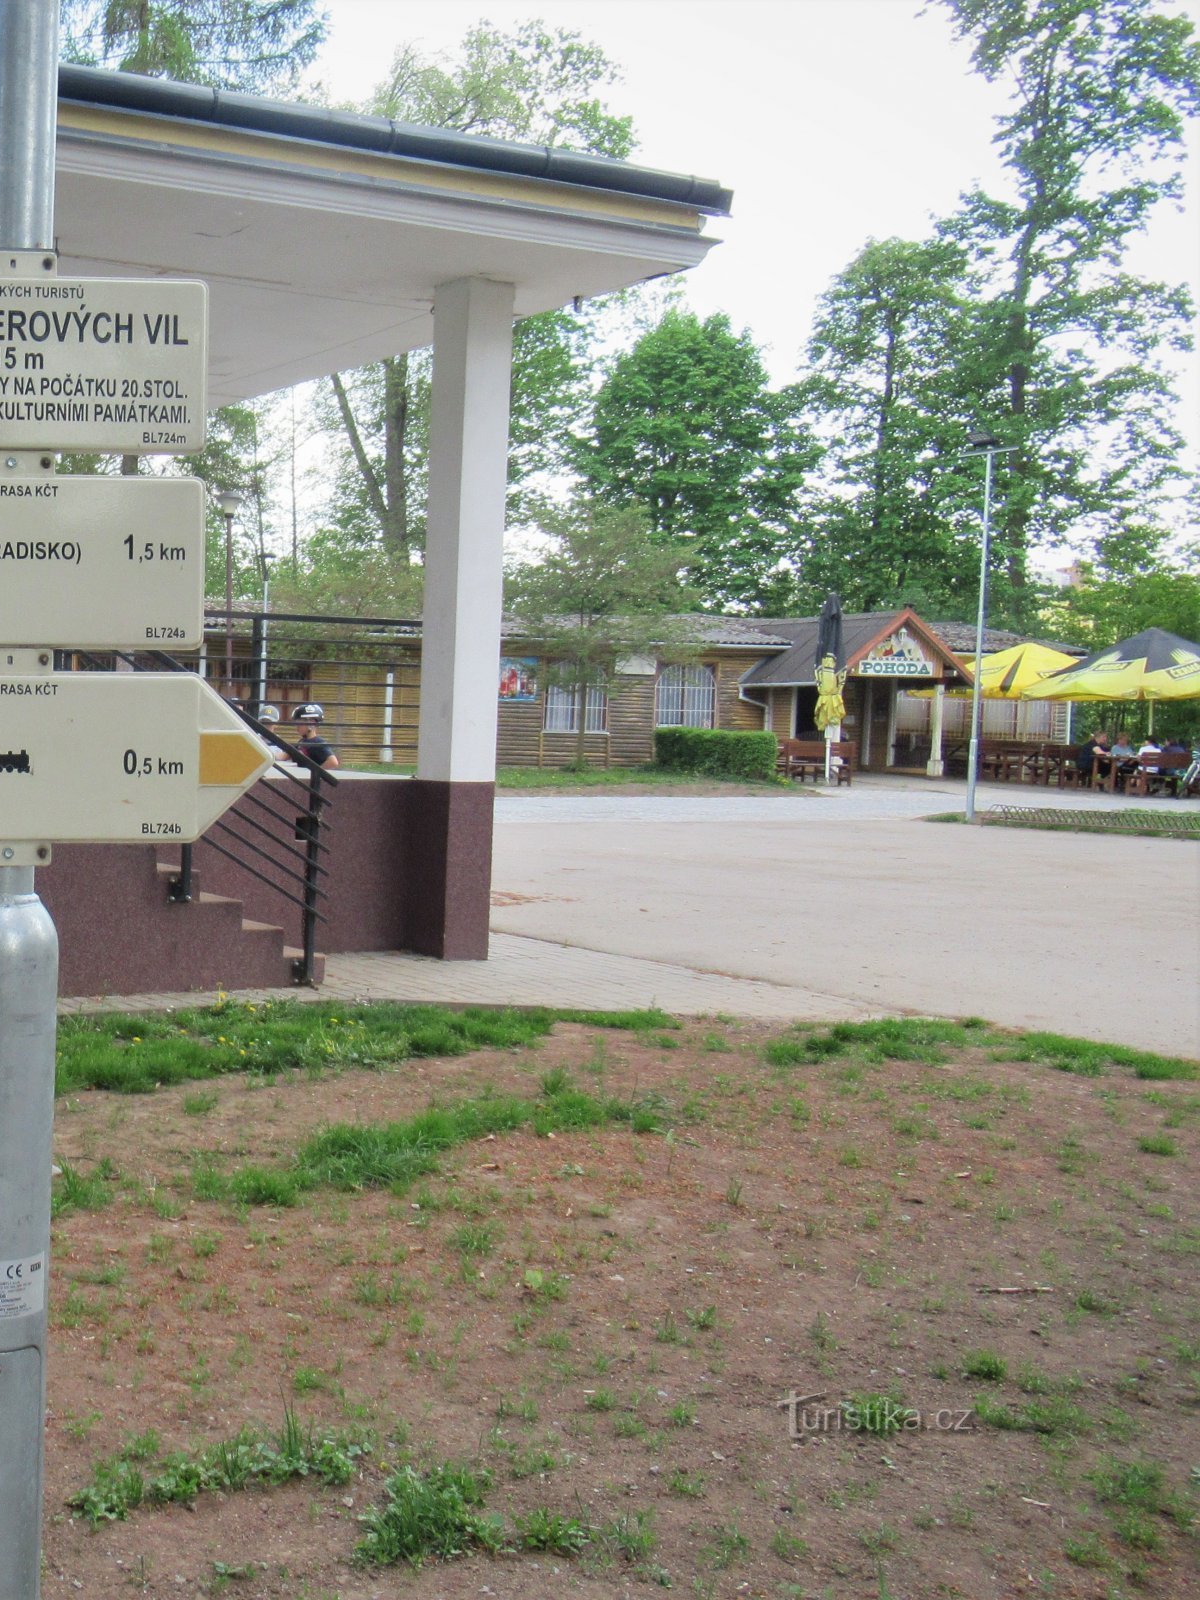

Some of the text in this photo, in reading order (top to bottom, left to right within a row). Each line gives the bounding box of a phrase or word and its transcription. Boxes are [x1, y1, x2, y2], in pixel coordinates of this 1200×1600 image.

[34, 284, 84, 300] TURISTŮ
[143, 313, 189, 346] VIL
[24, 352, 44, 370] m
[13, 376, 36, 396] NA
[40, 373, 117, 398] POČÁTKU
[121, 379, 188, 399] 20.STOL.
[93, 399, 191, 424] PAMÁTKAMI.
[142, 431, 187, 444] BL724m
[35, 483, 59, 498] KČT
[159, 542, 186, 561] km
[145, 626, 186, 639] BL724a
[861, 662, 931, 675] POHODA
[35, 681, 59, 696] KČT
[158, 757, 184, 775] km
[141, 822, 182, 834] BL724b
